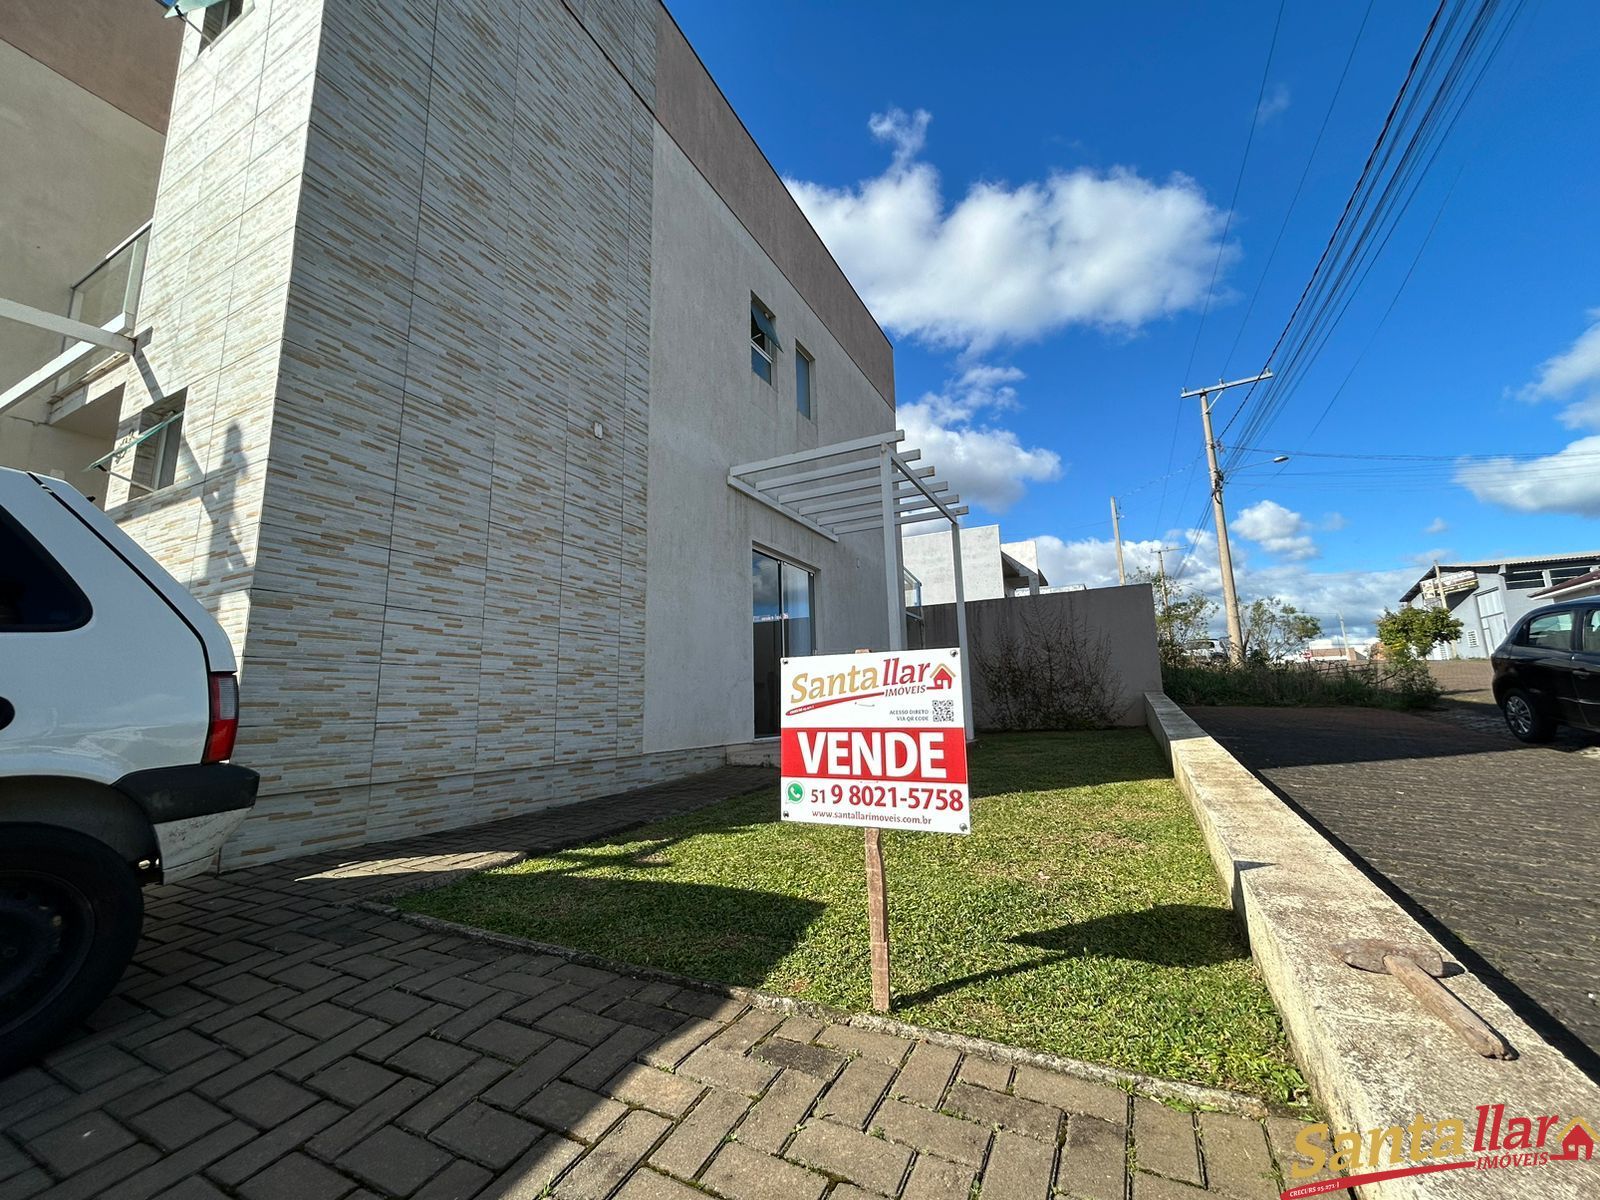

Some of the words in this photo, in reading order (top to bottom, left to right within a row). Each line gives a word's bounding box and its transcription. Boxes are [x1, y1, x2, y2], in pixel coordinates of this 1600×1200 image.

[885, 685, 926, 697] IMÓVEIS
[797, 731, 947, 779] VENDE
[811, 789, 826, 804] 51
[830, 784, 843, 804] 9
[848, 785, 964, 812] 8021-5758
[812, 810, 932, 825] www.santallarimoveis.com.br
